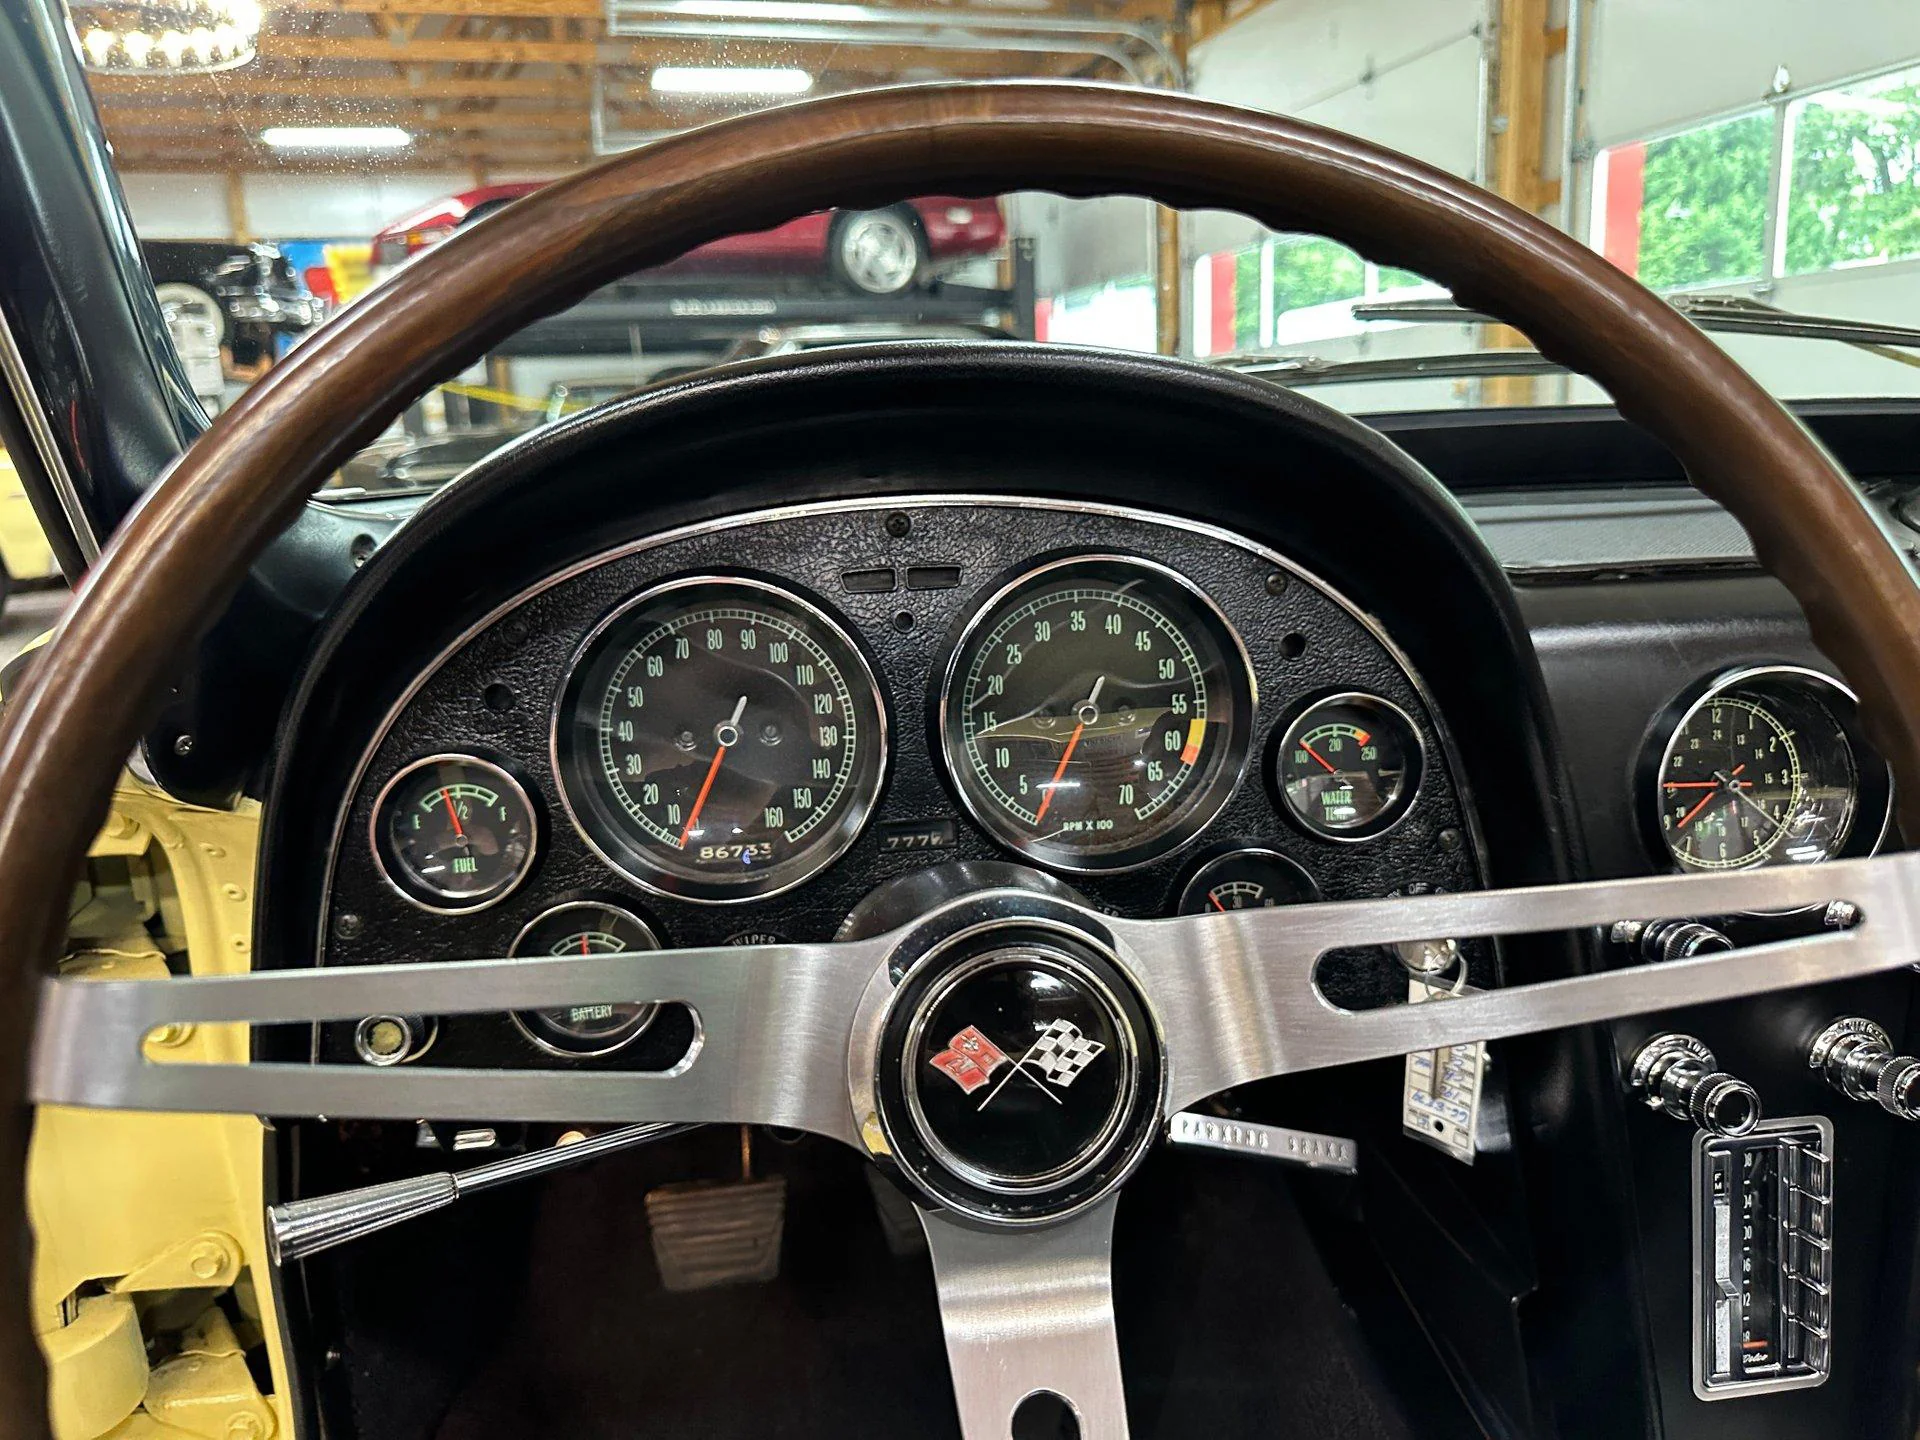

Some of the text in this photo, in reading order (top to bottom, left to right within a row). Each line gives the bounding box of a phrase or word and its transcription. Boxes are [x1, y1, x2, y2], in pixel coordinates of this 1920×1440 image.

[1070, 610, 1086, 631] 35
[1104, 613, 1122, 635] 40
[707, 629, 722, 650] 80
[740, 629, 756, 650] 90
[1034, 621, 1051, 642] 30
[1135, 630, 1151, 651] 45
[675, 638, 690, 659] 70
[769, 642, 788, 663] 100
[1006, 644, 1022, 664] 25
[647, 655, 663, 677] 60
[796, 665, 814, 686] 110
[1158, 658, 1175, 679] 50
[987, 674, 1004, 695] 20
[628, 686, 643, 708] 50
[814, 693, 832, 715] 120
[1171, 693, 1187, 715] 55
[983, 711, 997, 731] 15
[1711, 707, 1722, 724] 12
[1748, 714, 1754, 730] 1
[618, 720, 634, 742] 40
[820, 725, 838, 747] 130
[1164, 730, 1181, 751] 60
[1712, 729, 1722, 741] 24
[1736, 734, 1746, 746] 13
[1328, 738, 1342, 752] 210
[1361, 746, 1377, 761] 250
[1690, 738, 1700, 750] 23
[1754, 748, 1764, 760] 14
[1769, 737, 1777, 753] 2
[626, 753, 642, 775] 30
[995, 747, 1010, 768] 10
[1295, 750, 1308, 764] 100
[1673, 756, 1683, 768] 22
[812, 758, 830, 779] 140
[1147, 761, 1163, 782] 65
[1781, 768, 1789, 786] 3
[1019, 774, 1028, 795] 5
[1764, 774, 1773, 785] 15
[643, 783, 659, 805] 20
[793, 788, 812, 809] 150
[1119, 784, 1134, 805] 70
[1321, 790, 1352, 805] WATER
[412, 814, 421, 830] E
[499, 806, 507, 822] F
[667, 804, 680, 825] 10
[765, 807, 783, 828] 160
[1324, 806, 1349, 821] TE
[1773, 804, 1780, 820] 4
[1063, 820, 1113, 831] RPM X 100
[1753, 829, 1760, 846] 5
[1719, 842, 1727, 858] 6
[454, 857, 478, 873] FUEL
[733, 934, 776, 946] WIPER
[571, 1004, 613, 1022] BATTERY
